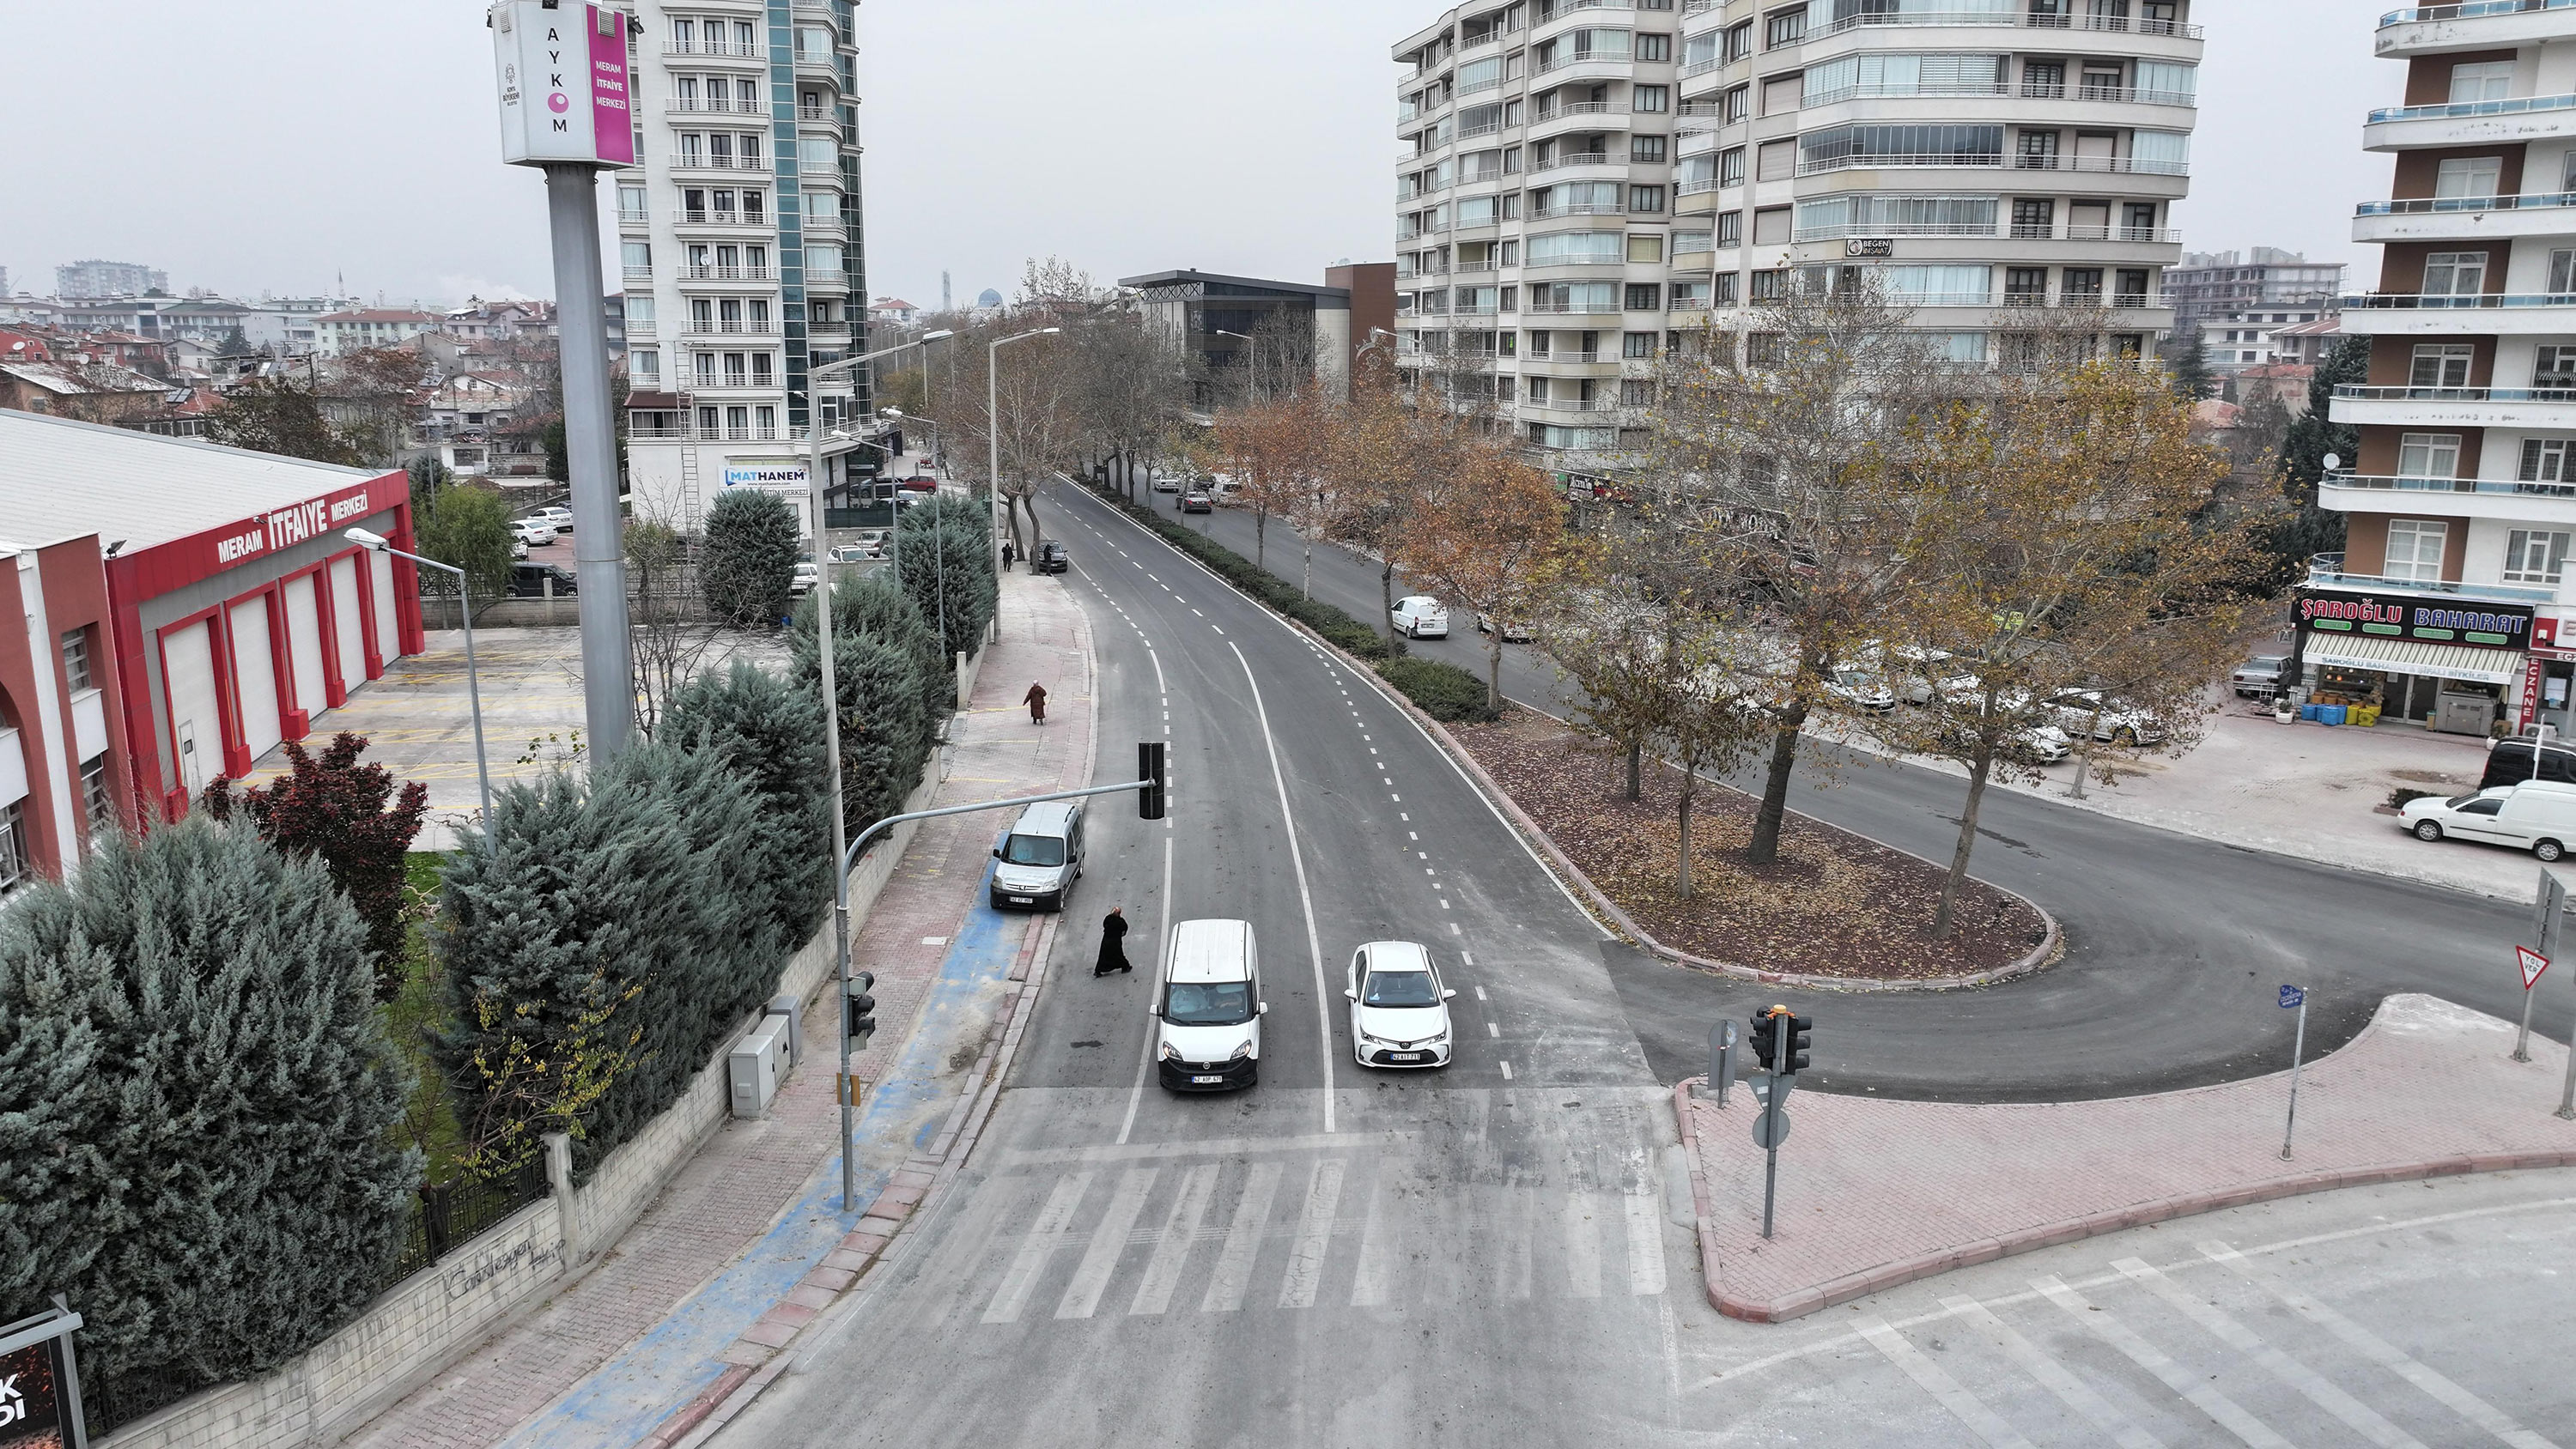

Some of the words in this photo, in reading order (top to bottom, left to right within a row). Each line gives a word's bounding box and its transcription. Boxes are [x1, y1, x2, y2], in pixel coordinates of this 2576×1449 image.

[596, 60, 622, 74] MERAM
[597, 77, 623, 92] İTFAİYE
[596, 96, 626, 110] MERKEZİ
[781, 488, 808, 496] MERKEZİ
[217, 529, 264, 564] MERAM
[268, 499, 328, 550] İTFAİYE
[331, 489, 368, 523] MERKEZİ
[2300, 597, 2403, 624] ŞAROĞLU
[2414, 607, 2528, 634] BAHARAT
[2321, 657, 2364, 667] ŞAROĞLU
[2523, 658, 2540, 717] ECZANE
[2524, 963, 2538, 973] VER
[2525, 955, 2540, 967] YOL
